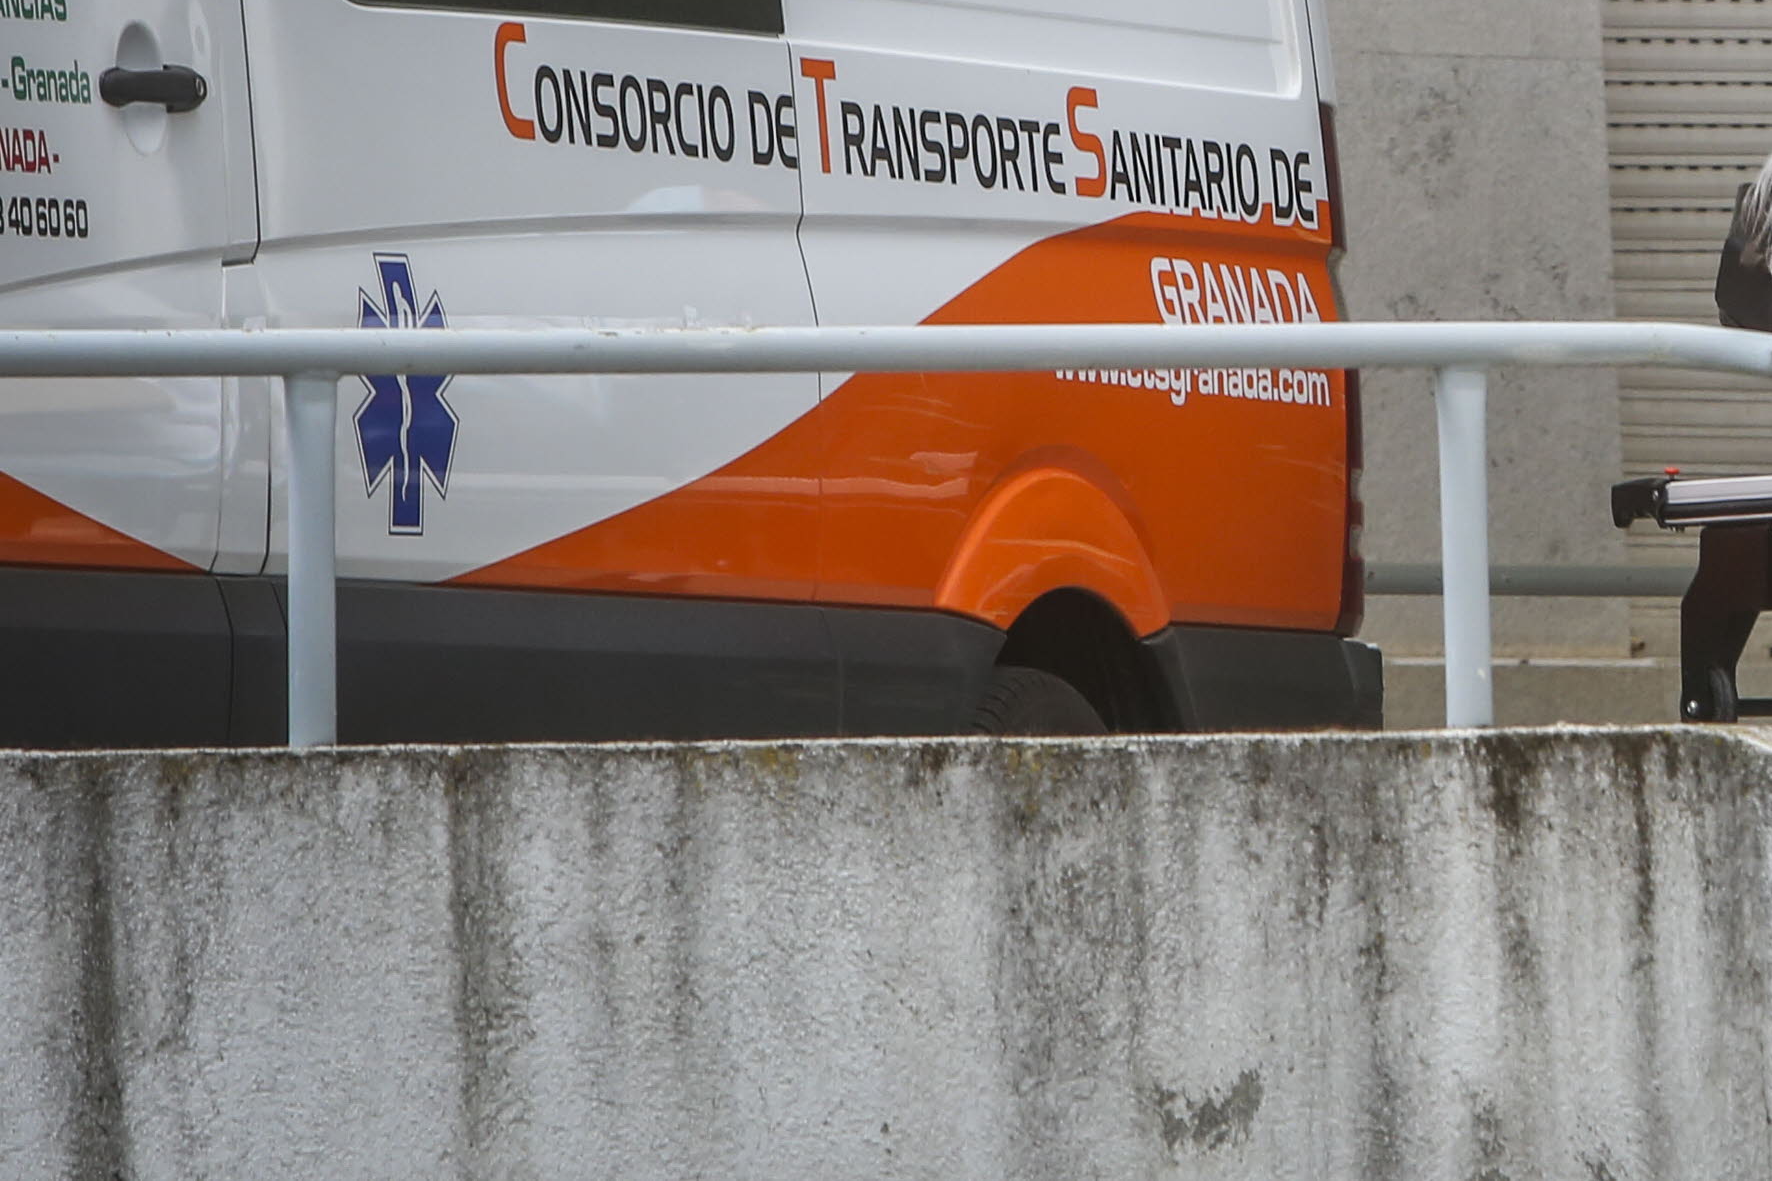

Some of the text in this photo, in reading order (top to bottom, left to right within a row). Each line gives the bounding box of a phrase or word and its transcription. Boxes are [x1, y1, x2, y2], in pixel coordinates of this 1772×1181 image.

[494, 22, 1316, 223] CONSORCIO DE TRANSPORTE SANITARIO DE
[1150, 256, 1321, 325] GRANADA
